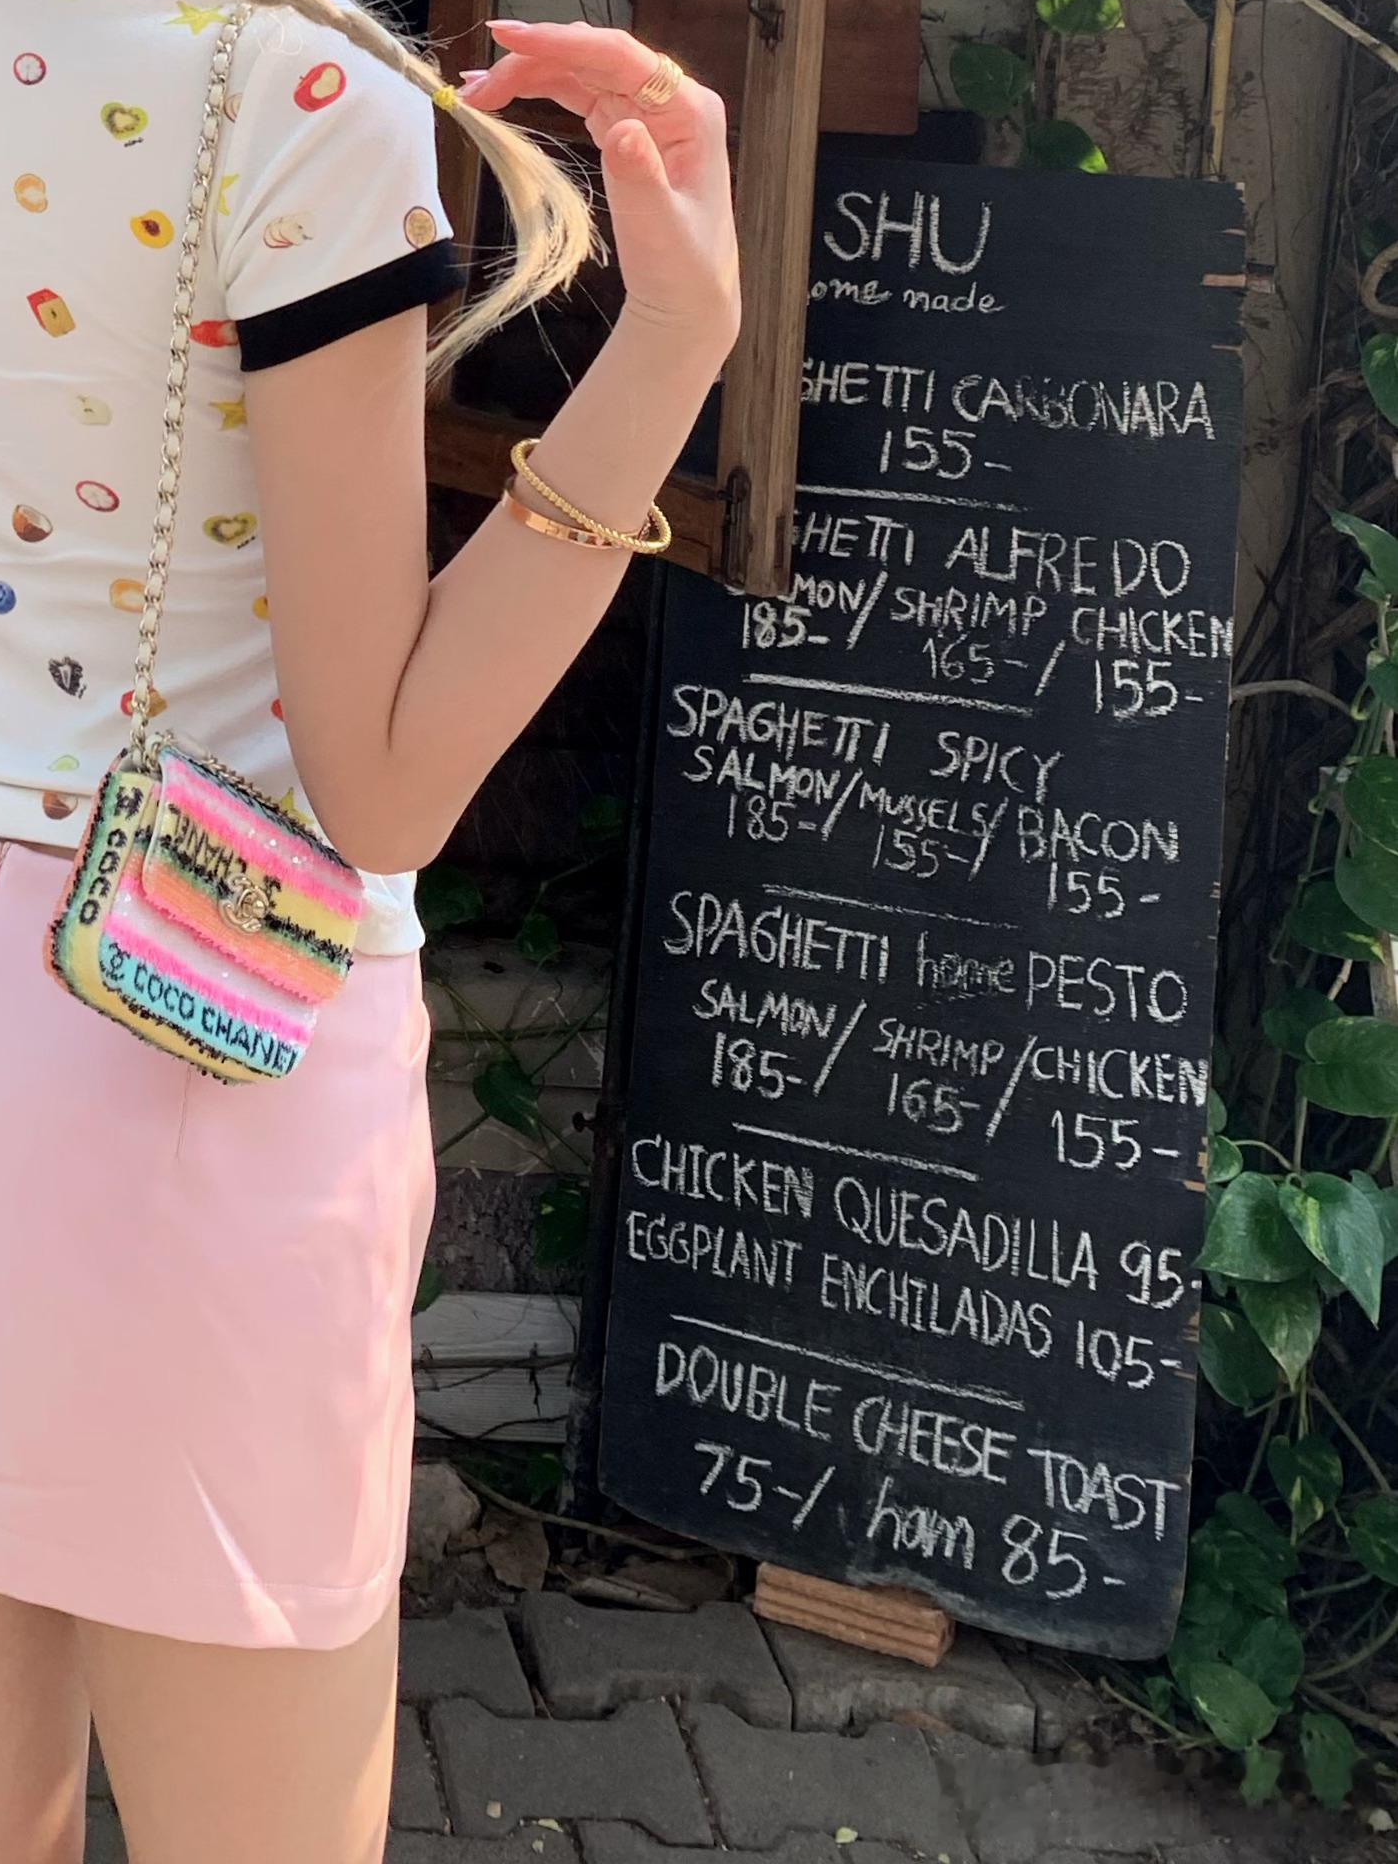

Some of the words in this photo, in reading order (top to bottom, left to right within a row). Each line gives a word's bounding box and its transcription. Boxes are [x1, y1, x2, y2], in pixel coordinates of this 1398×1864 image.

[824, 190, 992, 274] SHU
[807, 278, 893, 305] ome
[952, 374, 1216, 440] CARBONARA
[793, 510, 914, 566] HETTI
[945, 526, 1192, 599] ALFREDO
[890, 586, 1048, 637] SHRIMP
[1072, 606, 1234, 658] CHICKEN
[666, 684, 891, 766] SPAGHETTI
[929, 730, 1066, 804] SPICY
[79, 828, 128, 925] COCO
[1018, 807, 1180, 864] BACON
[134, 962, 196, 1020] COCO
[663, 891, 890, 984] SPAGHETTI
[1026, 950, 1188, 1024] PESTO
[1031, 1045, 1209, 1107] CHICKEN
[632, 1134, 814, 1219] CHICKEN
[834, 1176, 1100, 1291] QUESADILLA
[626, 1209, 803, 1292] EGGPLANT
[820, 1252, 1053, 1359] ENCHILADAS
[656, 1342, 842, 1441] DOUBLE
[852, 1396, 1017, 1485] CHEESE
[1027, 1448, 1182, 1541] TOAST
[867, 1475, 975, 1570] ham
